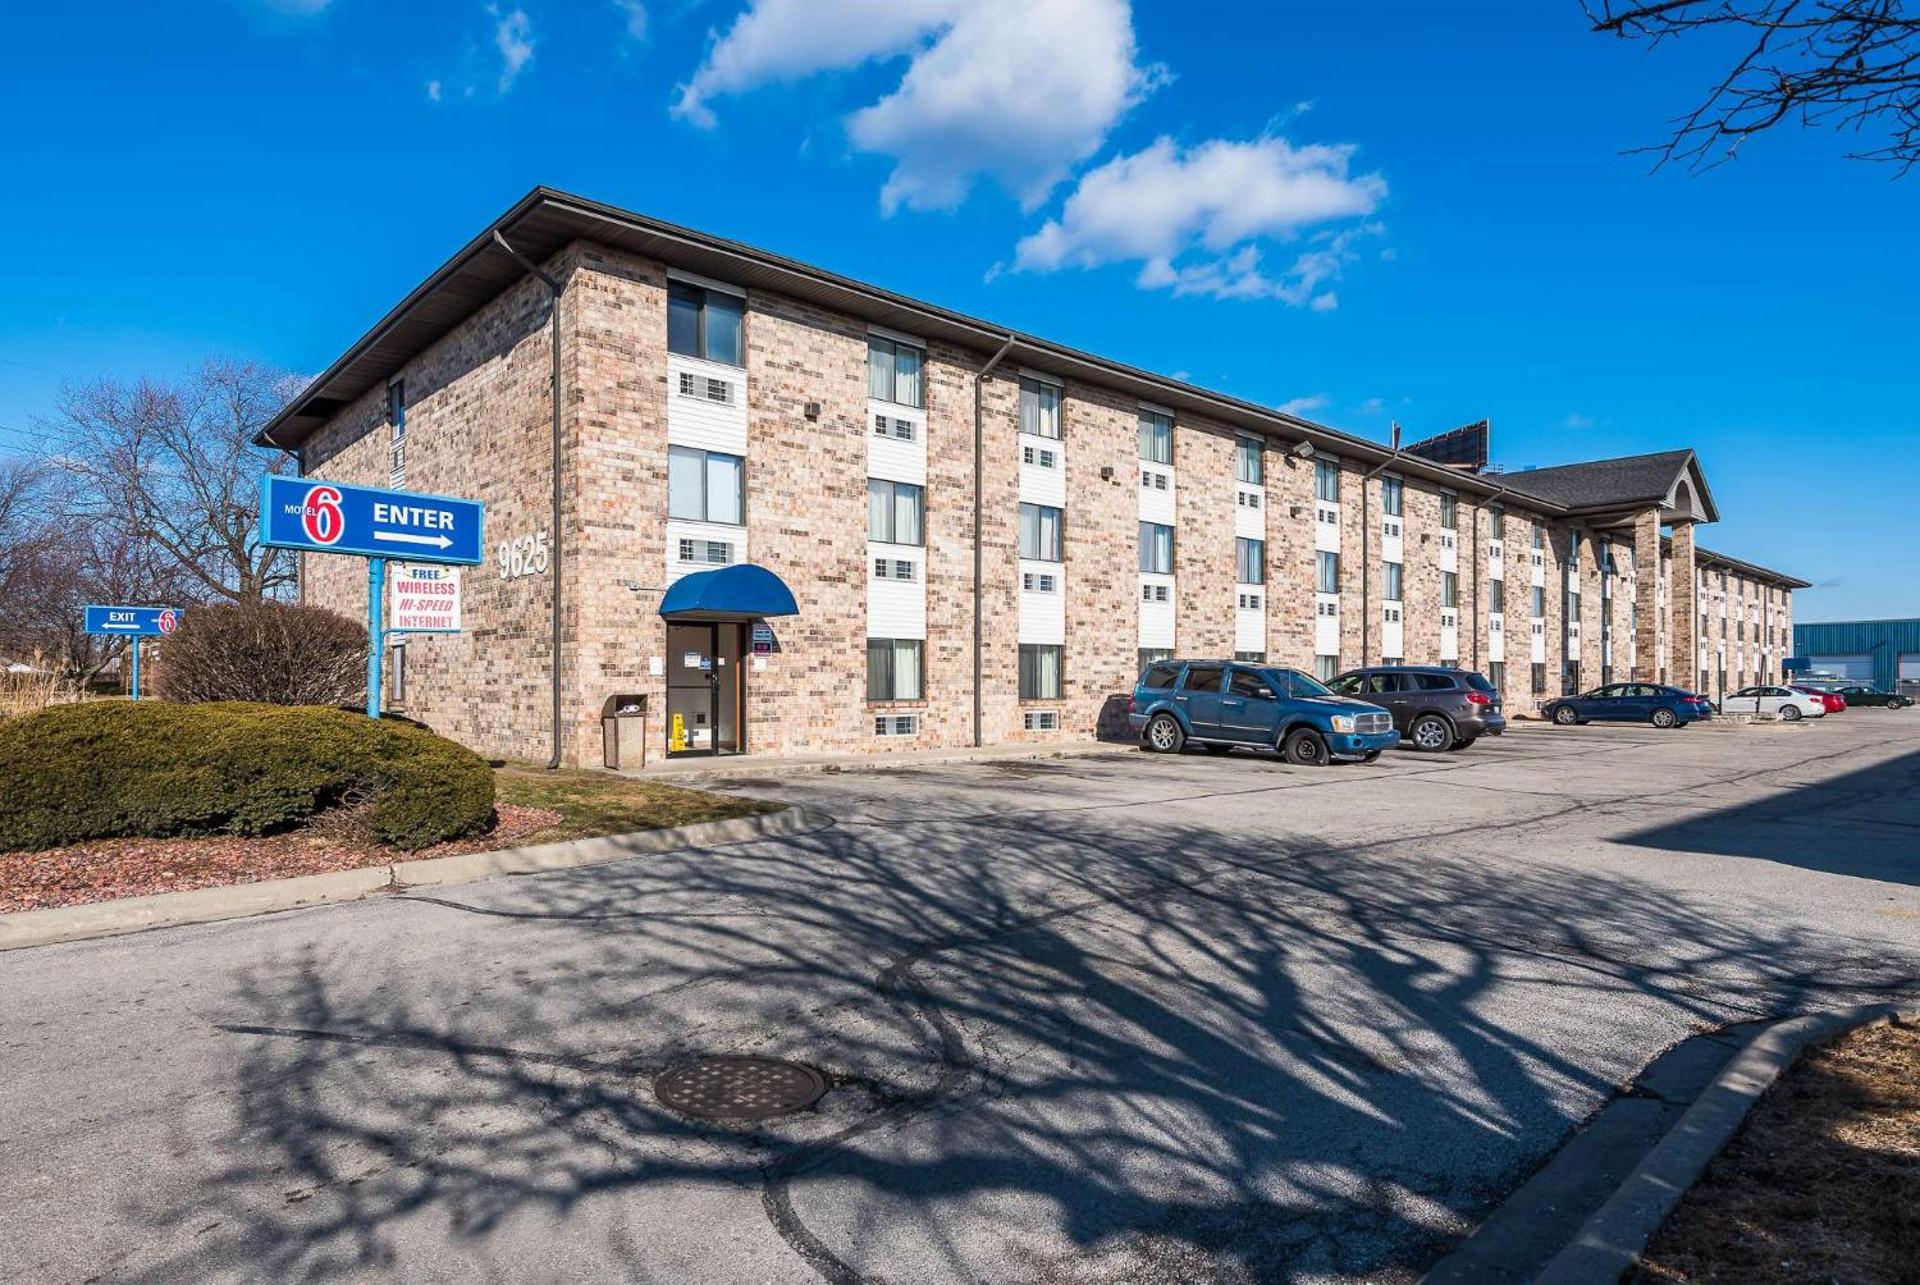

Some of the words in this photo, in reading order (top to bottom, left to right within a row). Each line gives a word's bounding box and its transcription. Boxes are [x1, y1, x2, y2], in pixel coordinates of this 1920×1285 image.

[301, 484, 345, 545] 6
[373, 502, 455, 531] ENTER
[499, 531, 548, 579] 9625
[412, 569, 440, 579] FREE
[397, 581, 455, 595] WIRELESS
[399, 598, 453, 611] HI-SPEED
[109, 612, 136, 622] EXIT
[158, 610, 177, 634] 6
[399, 615, 452, 628] INTERNET
